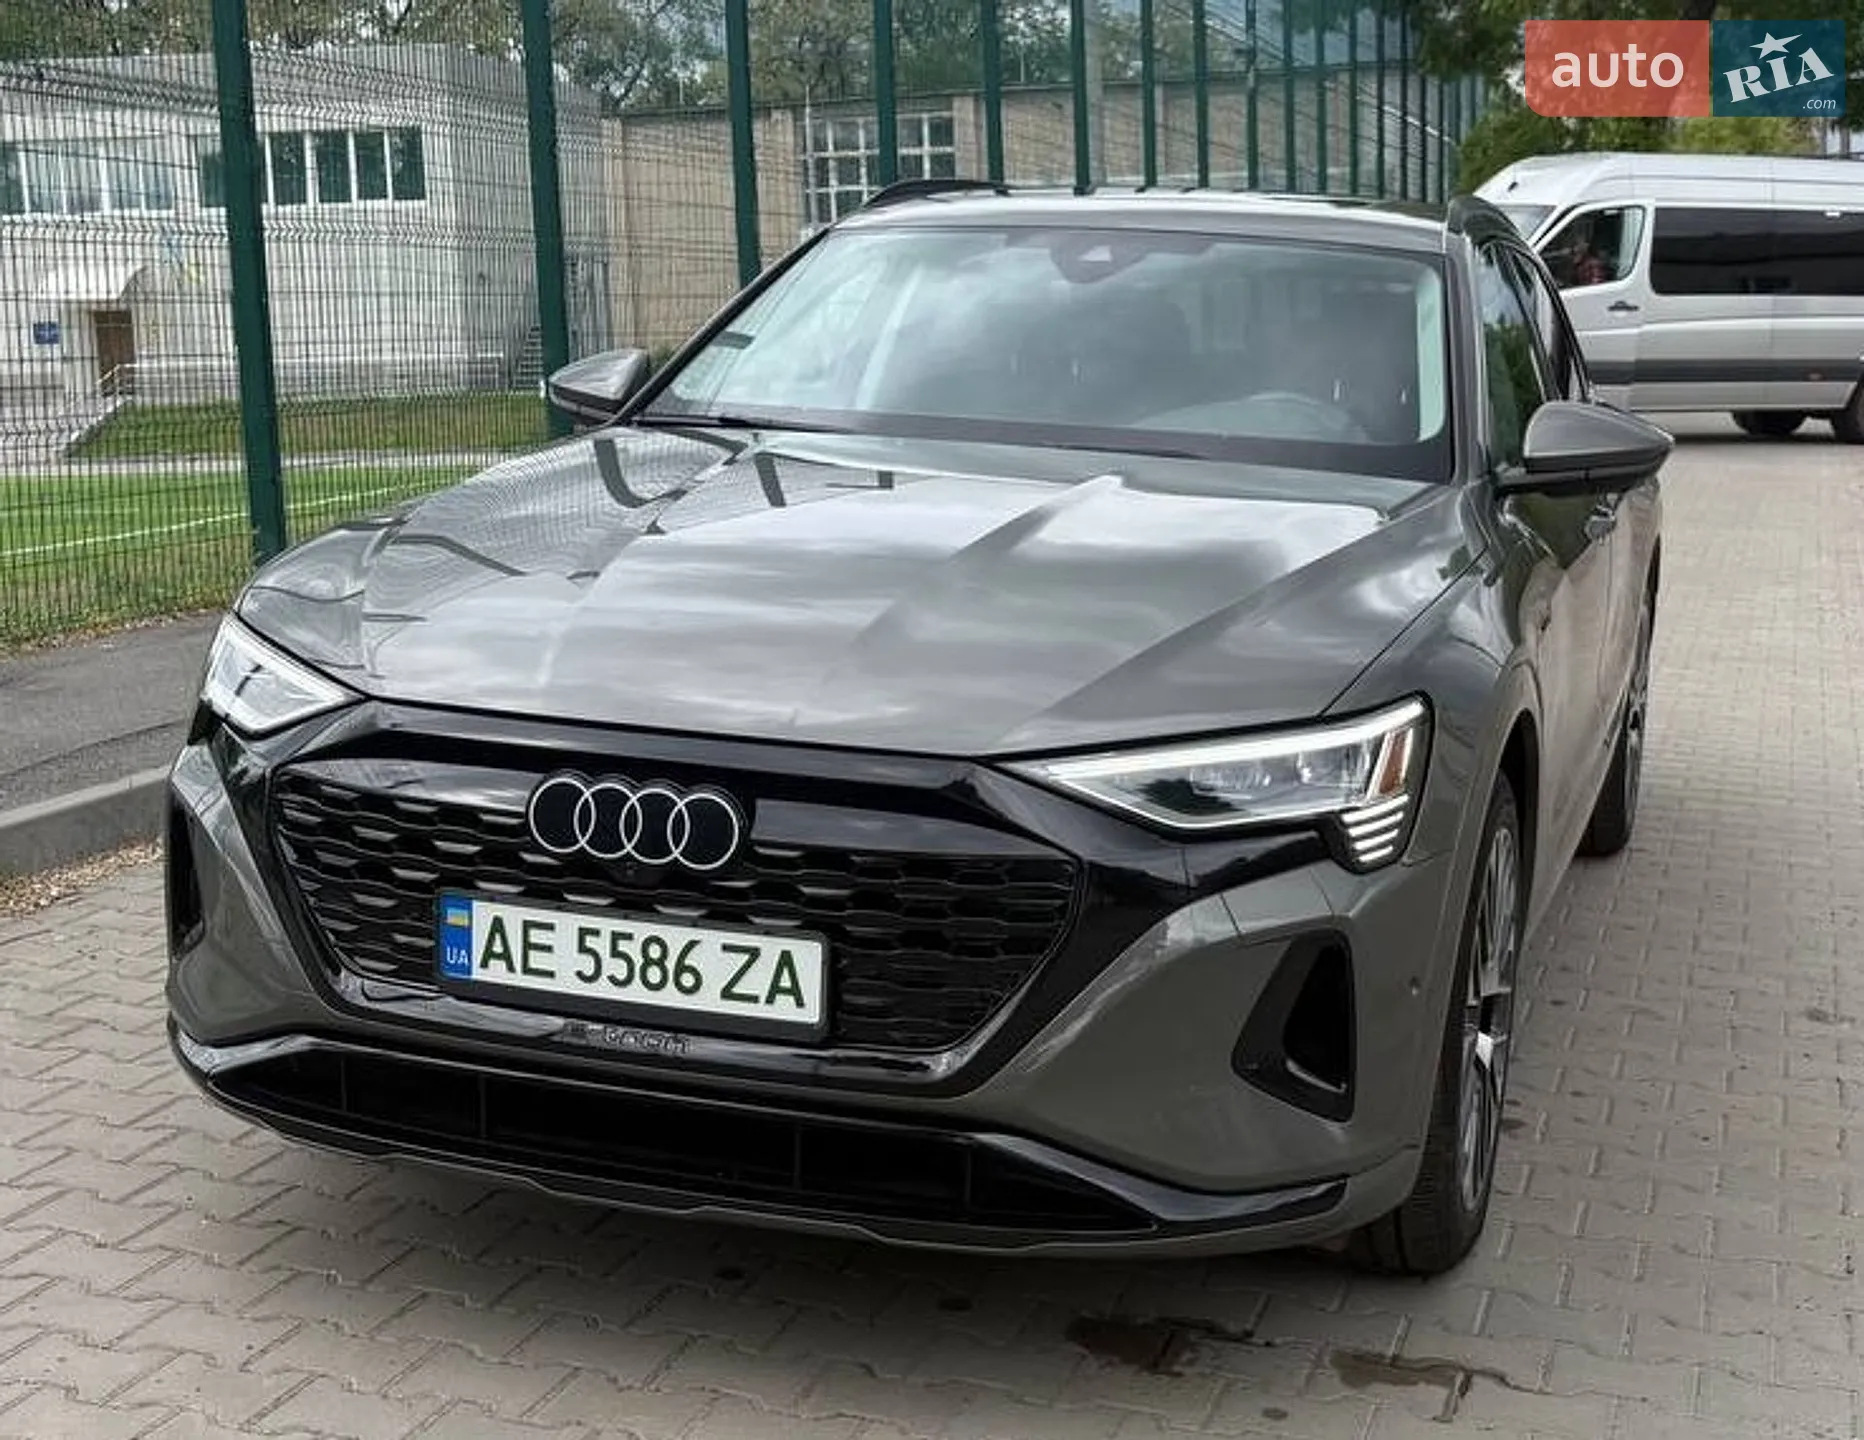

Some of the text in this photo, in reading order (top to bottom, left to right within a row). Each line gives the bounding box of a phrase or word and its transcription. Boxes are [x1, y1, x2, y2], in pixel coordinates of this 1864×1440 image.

[446, 947, 469, 967] UA
[479, 914, 805, 1009] AE 5586 ZA
